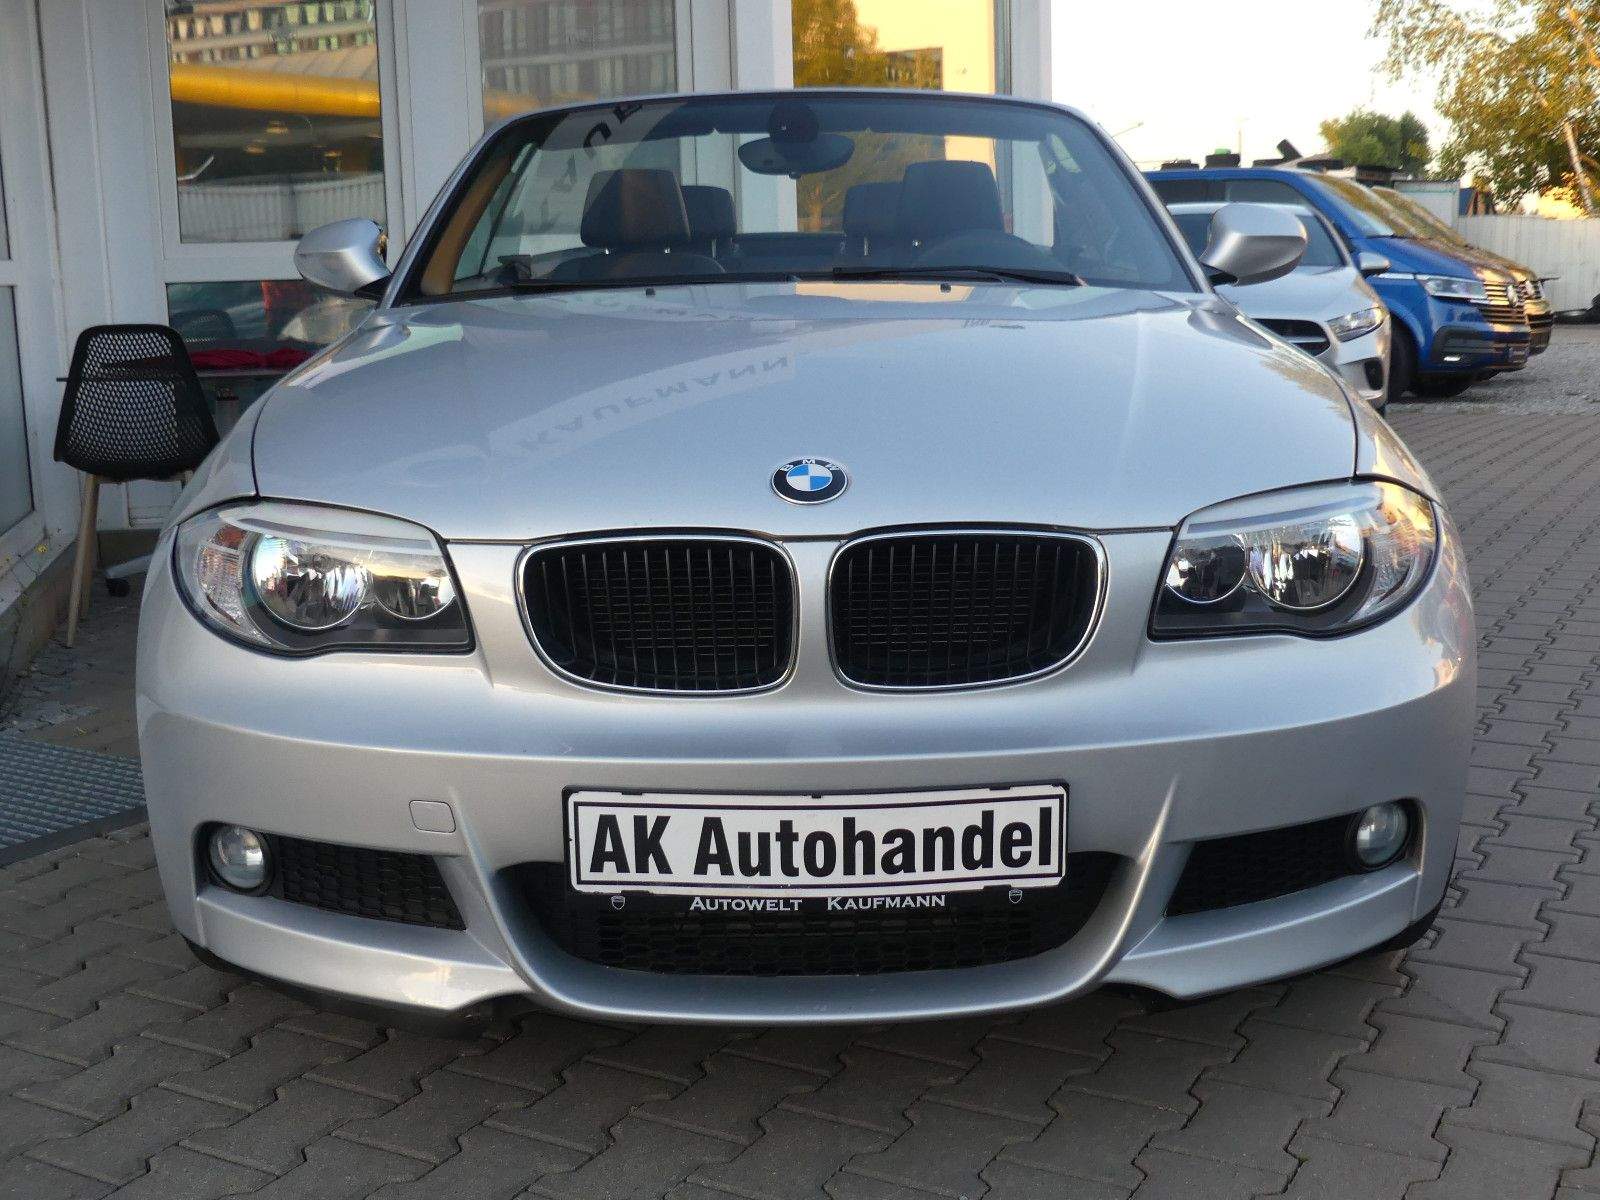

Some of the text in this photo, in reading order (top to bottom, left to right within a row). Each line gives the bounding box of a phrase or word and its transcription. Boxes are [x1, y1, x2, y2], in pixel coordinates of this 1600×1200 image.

[779, 458, 841, 472] BMW
[589, 806, 1052, 878] AK Autohandel
